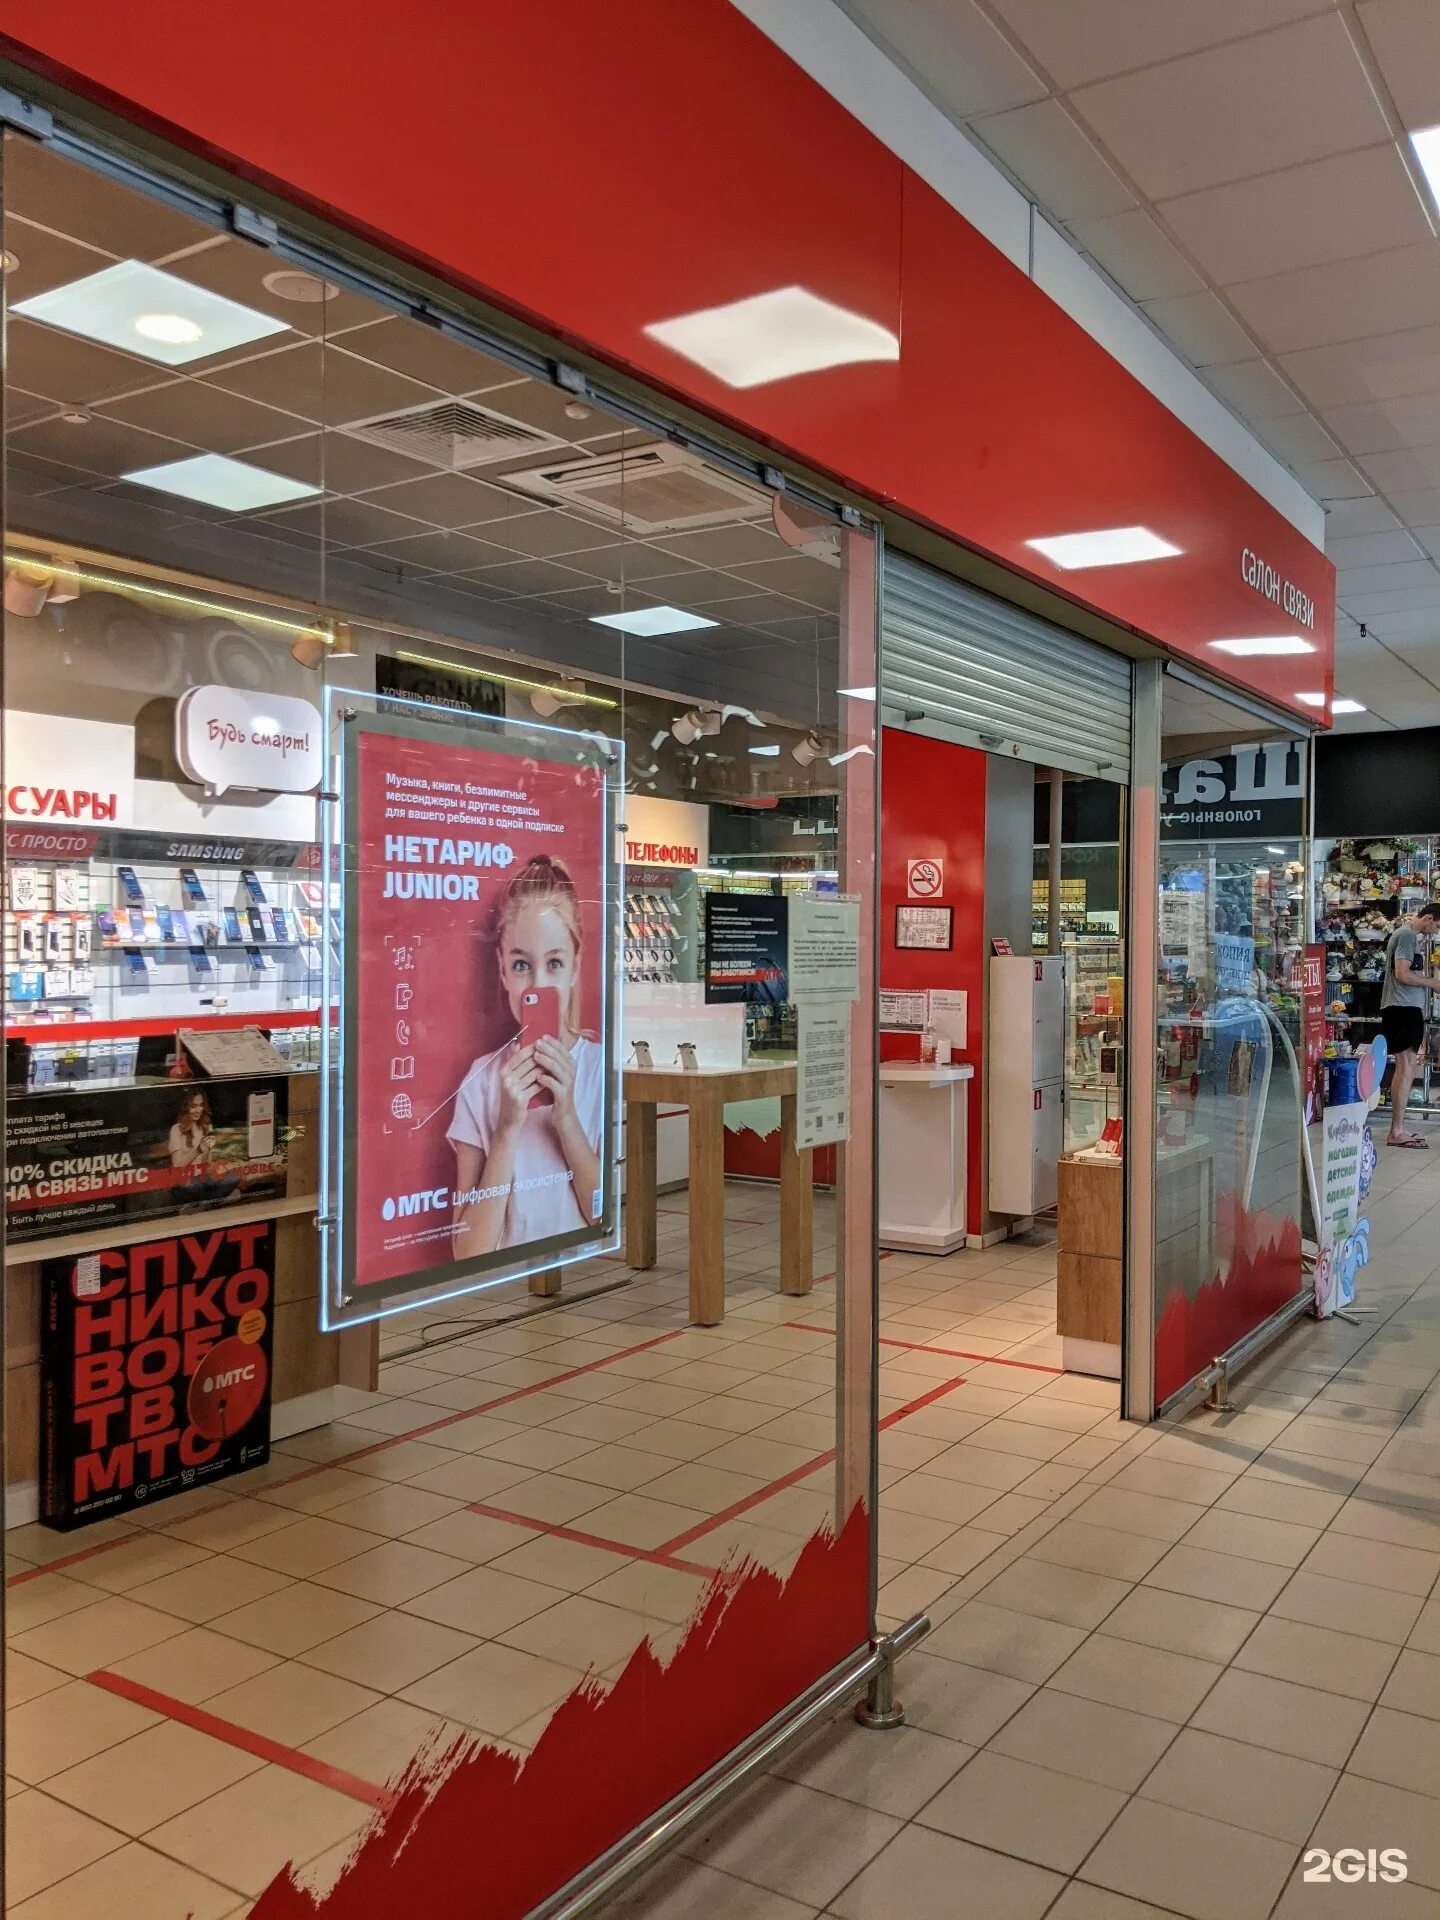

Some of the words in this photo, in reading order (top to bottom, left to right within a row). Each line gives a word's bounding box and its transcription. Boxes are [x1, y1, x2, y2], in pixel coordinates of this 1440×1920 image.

[1241, 548, 1280, 605] салон
[1283, 580, 1314, 630] связи
[425, 695, 472, 711] РАБОТАТЬ
[207, 719, 246, 750] Будь
[251, 732, 310, 759] смарт!
[385, 773, 431, 791] Музыка,
[432, 781, 463, 795] книги,
[465, 783, 527, 801] безлимитные
[385, 791, 458, 808] мессенджеры
[459, 800, 466, 808] и
[468, 801, 500, 814] другие
[502, 805, 540, 817] сервисы
[385, 807, 405, 818] для
[408, 809, 445, 822] вашего
[448, 813, 487, 826] ребенка
[488, 818, 494, 826] в
[496, 818, 523, 830] одной
[525, 821, 565, 833] подписке
[21, 834, 88, 851] ПРОСТО
[167, 843, 244, 861] SAMSUNG
[385, 835, 514, 869] НЕТАРИФ
[626, 841, 699, 865] ТЕЛЕФОНЫ
[383, 872, 480, 901] JUNIOR
[14, 1124, 49, 1135] скидкой
[62, 1121, 68, 1129] 6
[69, 1119, 104, 1129] месяцев
[35, 1112, 66, 1123] тарифа
[6, 1139, 19, 1149] ри
[20, 1132, 76, 1145] подключении
[77, 1126, 129, 1139] автоплатежа
[49, 1151, 133, 1177] СКИДКА
[5, 1184, 32, 1202] НА
[36, 1174, 104, 1198] СВЯЗЬ
[107, 1167, 149, 1188] МТС
[398, 1187, 449, 1217] МТС
[452, 1181, 511, 1207] Цифровая
[513, 1169, 574, 1194] экосистема
[12, 1215, 34, 1225] Быть
[35, 1211, 62, 1223] лучше
[63, 1204, 96, 1216] каждый
[96, 1203, 116, 1213] день
[74, 1268, 269, 1355] НИКО
[215, 1364, 256, 1391] МТС
[73, 1385, 176, 1450] ТВ
[73, 1424, 222, 1504] МТС
